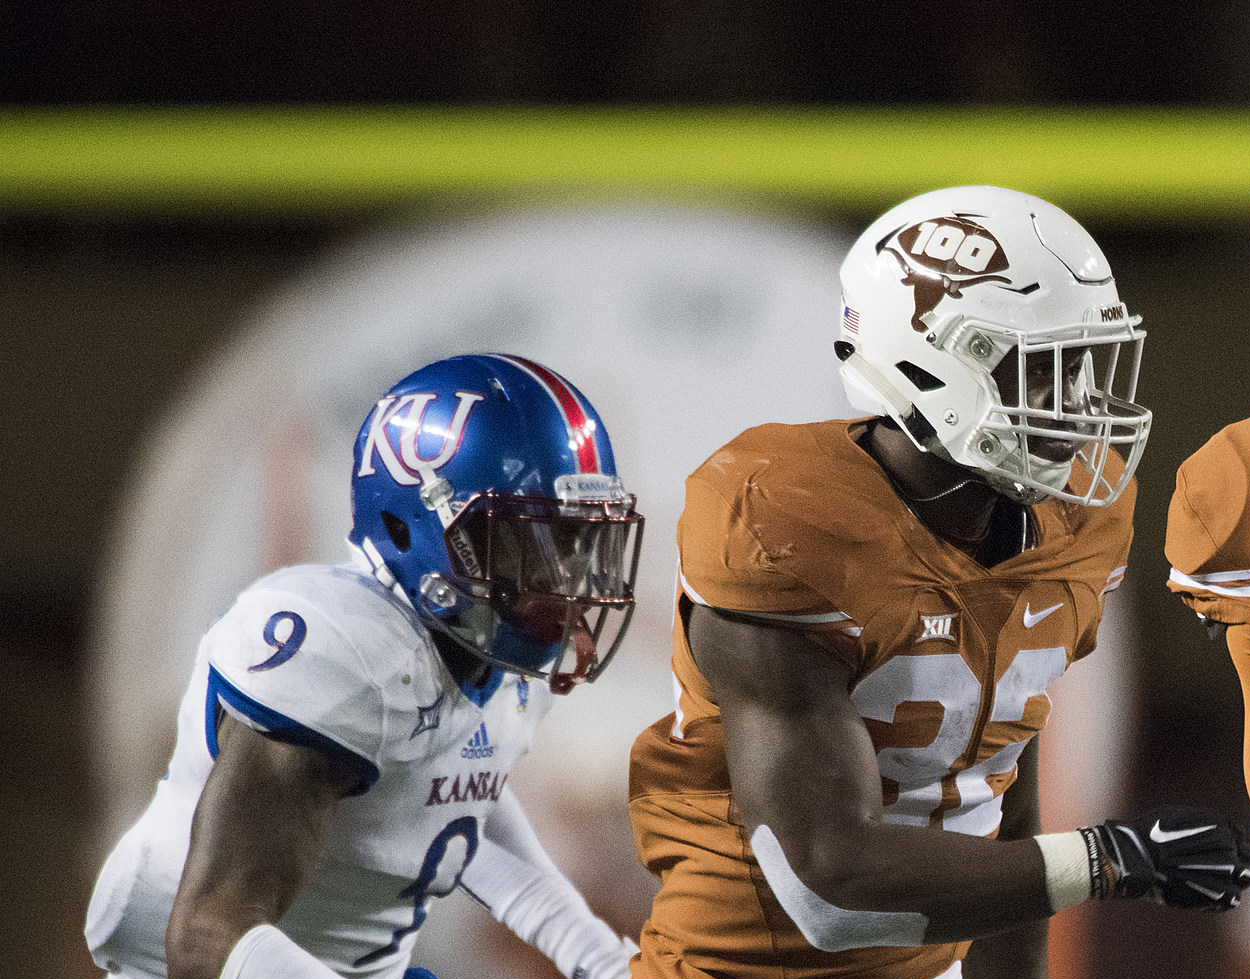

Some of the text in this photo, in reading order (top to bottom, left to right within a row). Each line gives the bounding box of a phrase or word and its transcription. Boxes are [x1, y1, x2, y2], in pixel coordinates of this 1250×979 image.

[910, 221, 998, 273] 100
[1100, 305, 1124, 323] HORNS
[357, 391, 485, 486] KU
[246, 611, 309, 674] 9
[916, 613, 958, 643] XII
[424, 771, 509, 807] KANSA
